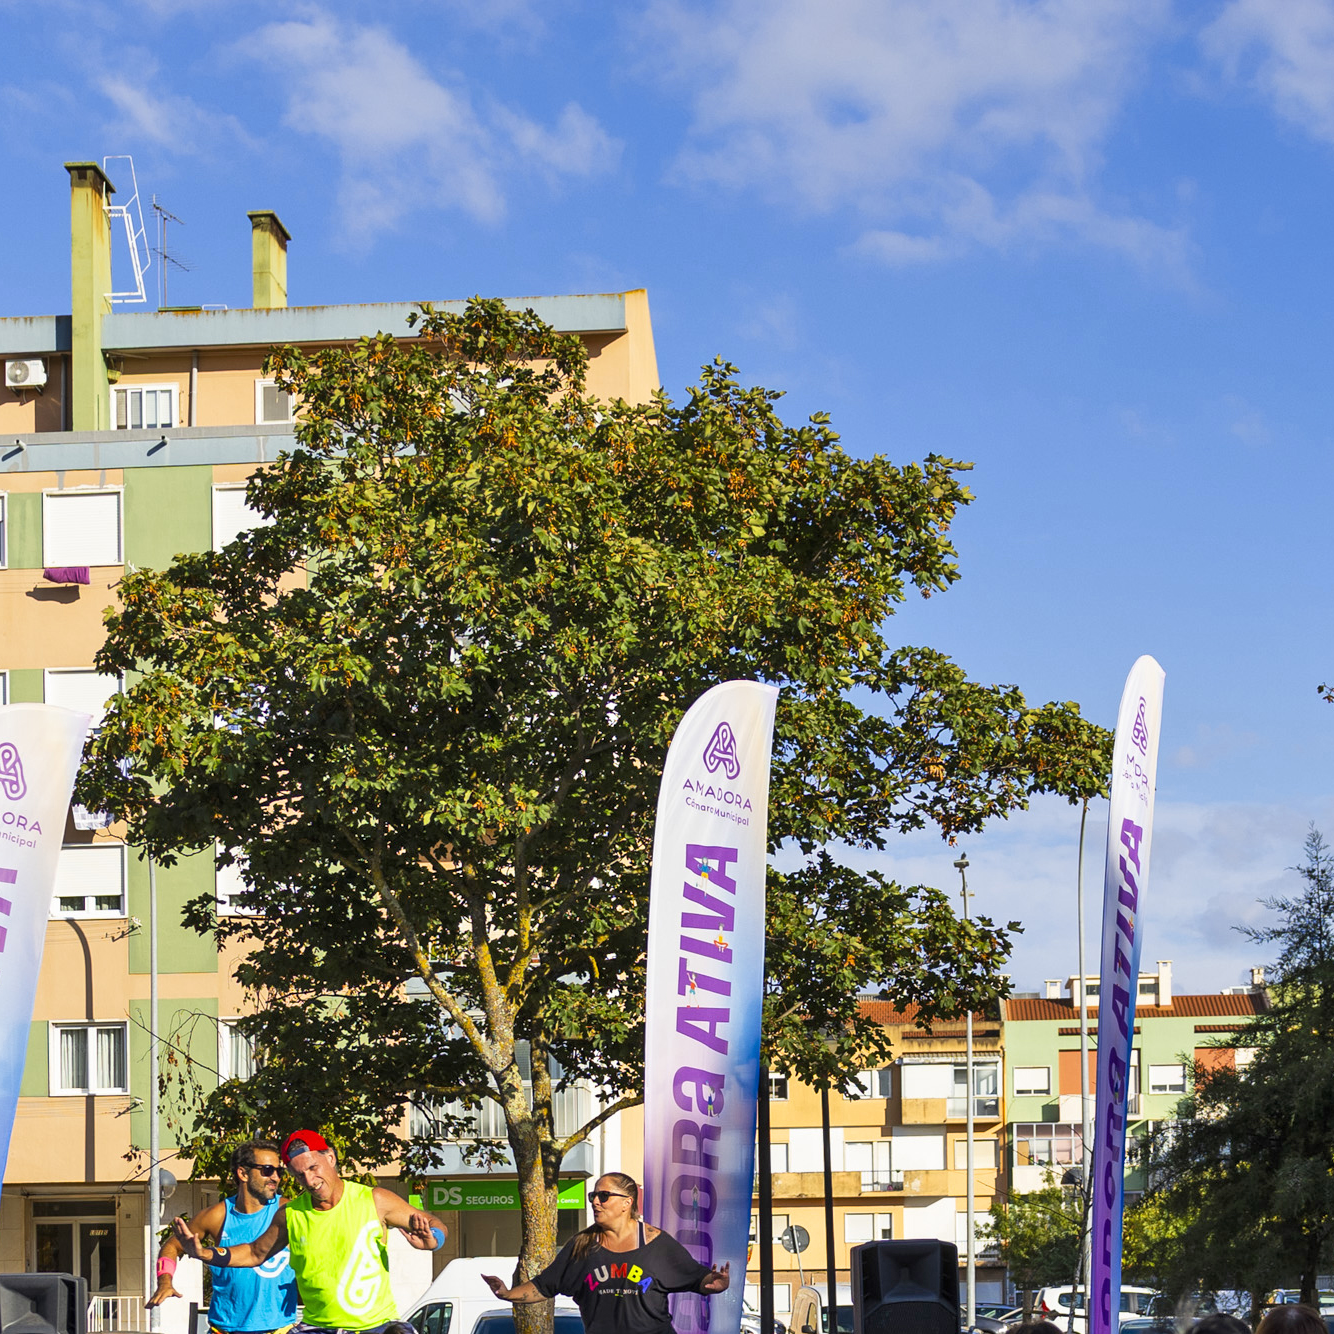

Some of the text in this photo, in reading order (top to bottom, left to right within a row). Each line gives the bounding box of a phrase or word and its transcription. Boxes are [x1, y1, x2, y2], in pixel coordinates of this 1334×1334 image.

[683, 779, 753, 812] AMADORA
[1112, 817, 1144, 1042] ATIVA
[675, 843, 739, 1056] ATIVA
[433, 1186, 515, 1205] DS SEGUROS
[584, 1262, 653, 1294] ZUMBA
